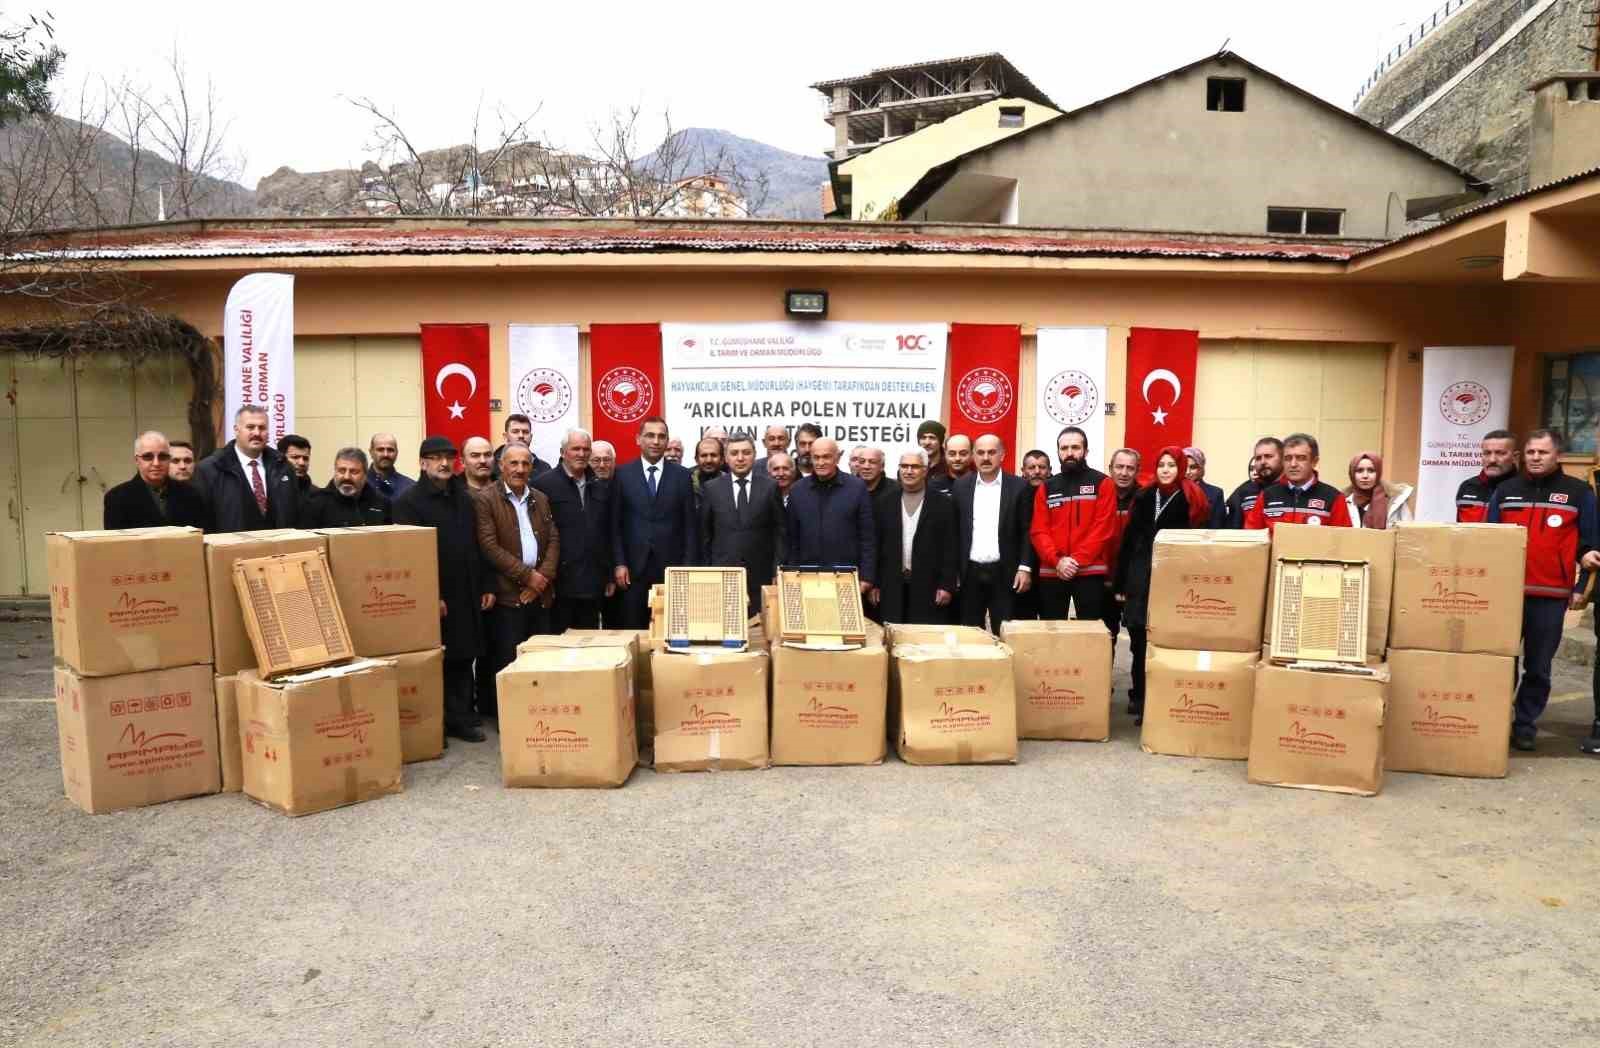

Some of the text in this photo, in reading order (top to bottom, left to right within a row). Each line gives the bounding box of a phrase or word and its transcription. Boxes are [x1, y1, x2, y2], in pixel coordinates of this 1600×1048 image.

[240, 310, 253, 364] VALİLİĞİ
[258, 352, 269, 402] ORMAN
[791, 400, 847, 417] POLEN
[852, 402, 926, 419] TUZAKLI
[700, 425, 757, 441] KVAN
[835, 423, 910, 442] DESTEĞİ
